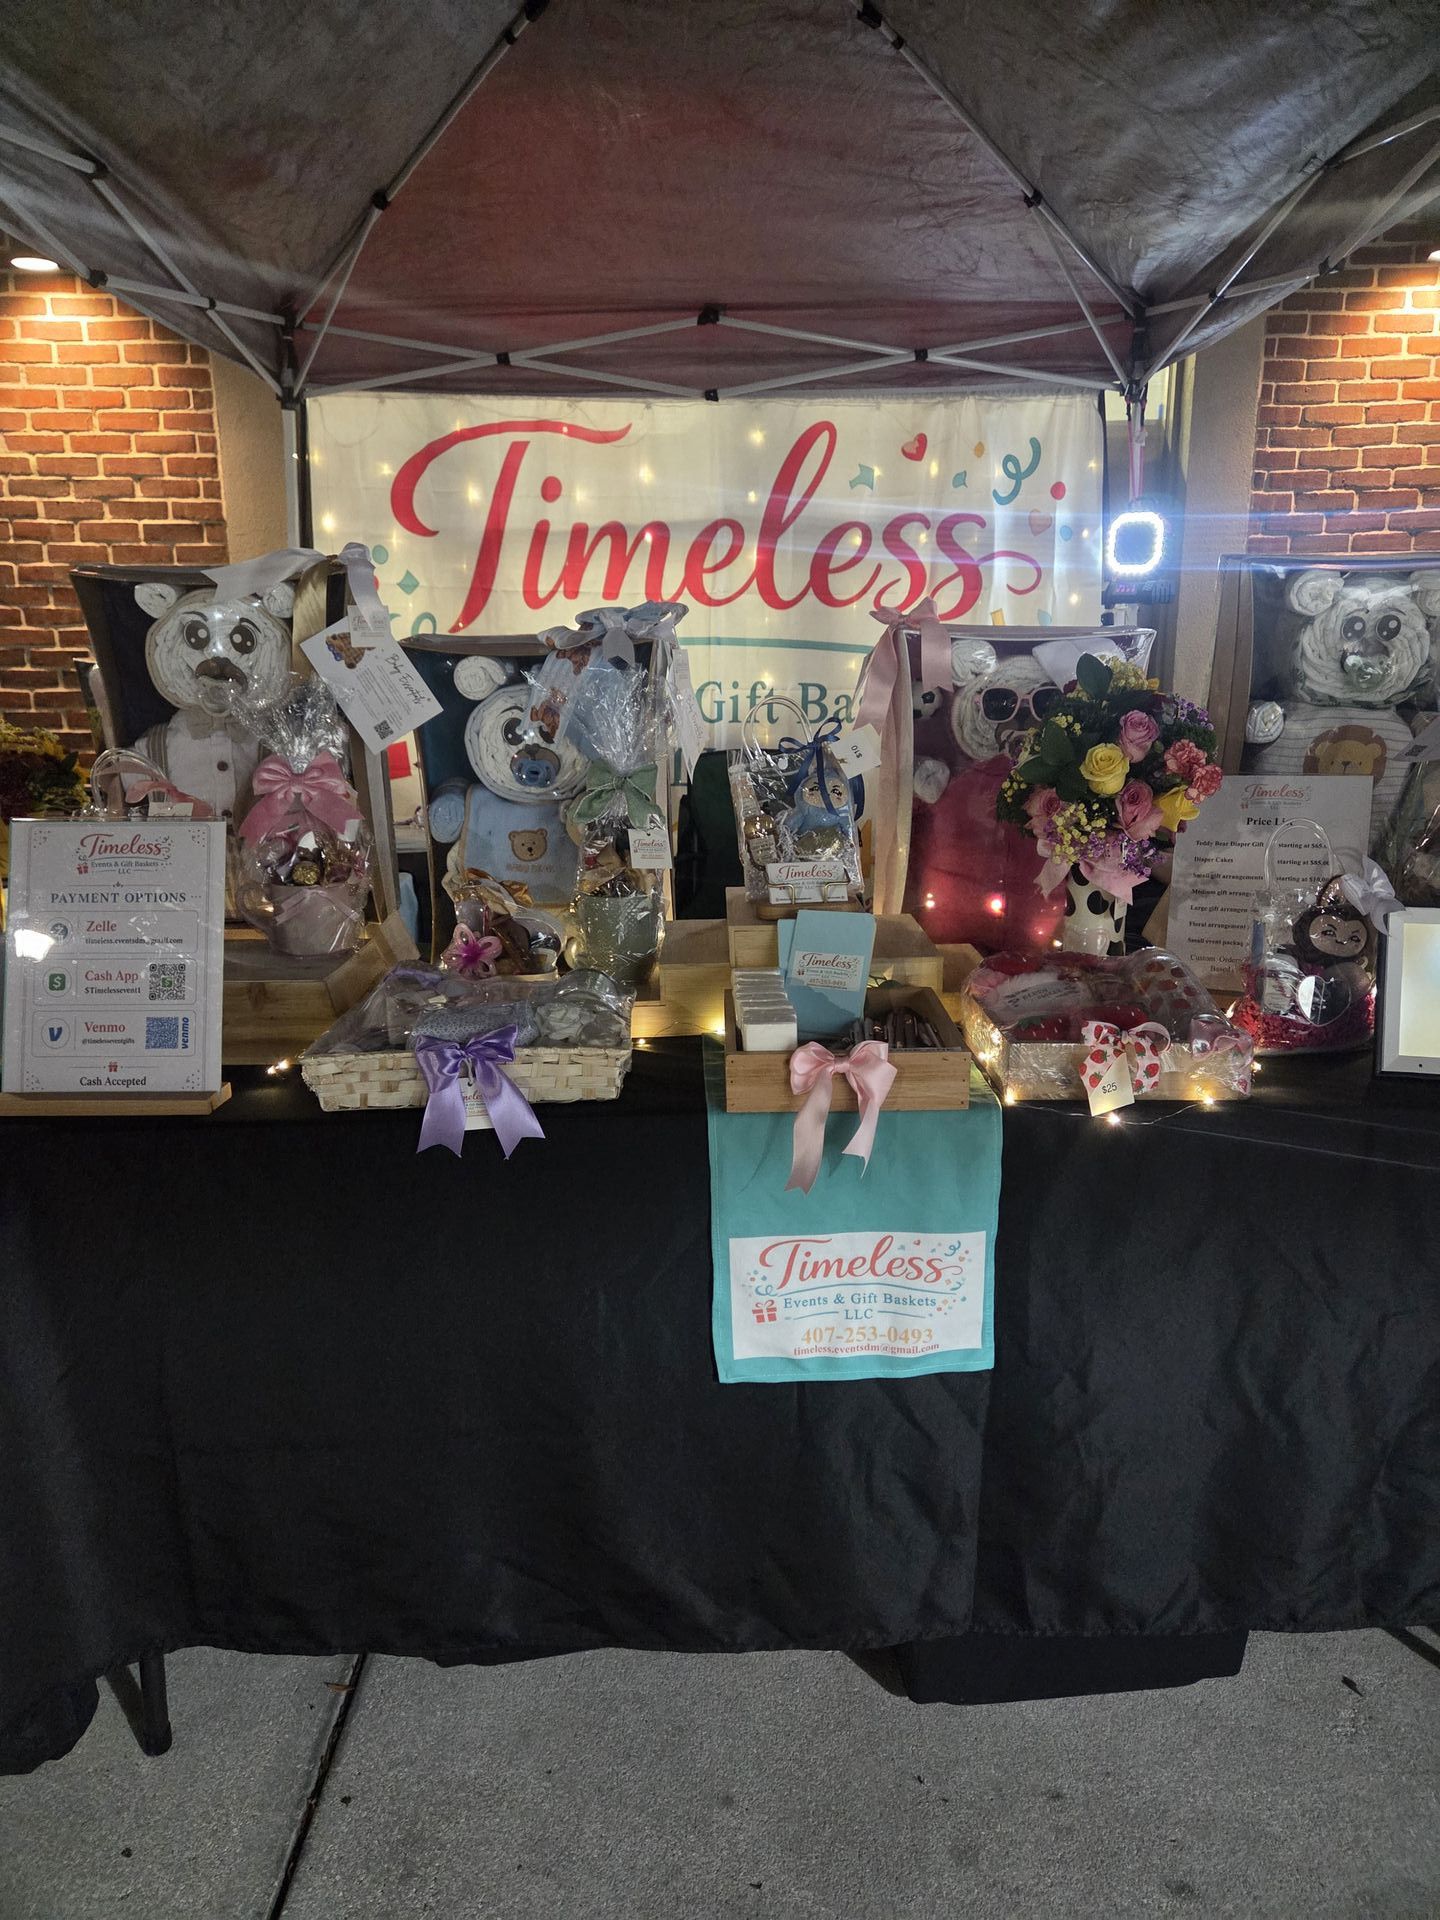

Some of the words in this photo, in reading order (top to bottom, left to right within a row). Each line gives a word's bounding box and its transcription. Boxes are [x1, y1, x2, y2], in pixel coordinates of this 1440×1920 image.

[391, 420, 1041, 634] Timeless
[695, 681, 780, 725] Gift
[851, 745, 863, 759] $10
[1244, 783, 1307, 800] Timeless
[1246, 817, 1272, 826] Price
[80, 834, 167, 859] Timeless
[1195, 840, 1214, 848] Teddy
[1230, 840, 1250, 849] Diaper
[134, 860, 159, 869] Baskets
[1193, 856, 1214, 864] Diaper
[779, 864, 833, 881] Timeless
[1276, 875, 1299, 883] starting
[50, 892, 118, 904] PAYMENT
[124, 892, 187, 903] OPTIONS
[1209, 905, 1219, 913] gift
[86, 921, 117, 933] Zelle
[802, 952, 852, 969] Timeless
[85, 970, 112, 982] Cash
[114, 970, 139, 984] App
[84, 1022, 125, 1033] Venmo
[181, 1016, 189, 1050] venmo
[79, 1076, 102, 1087] Cash
[103, 1076, 146, 1088] Accepted
[1101, 1081, 1118, 1094] $25
[759, 1234, 962, 1290] Timeless
[783, 1293, 829, 1309] Events
[833, 1293, 846, 1305] &
[850, 1291, 878, 1304] Gift
[882, 1292, 937, 1307] Baskets
[844, 1308, 874, 1321] LLC
[801, 1325, 933, 1345] 407-253-0493
[793, 1341, 940, 1356] timeless.eventsdm@gmail.com
